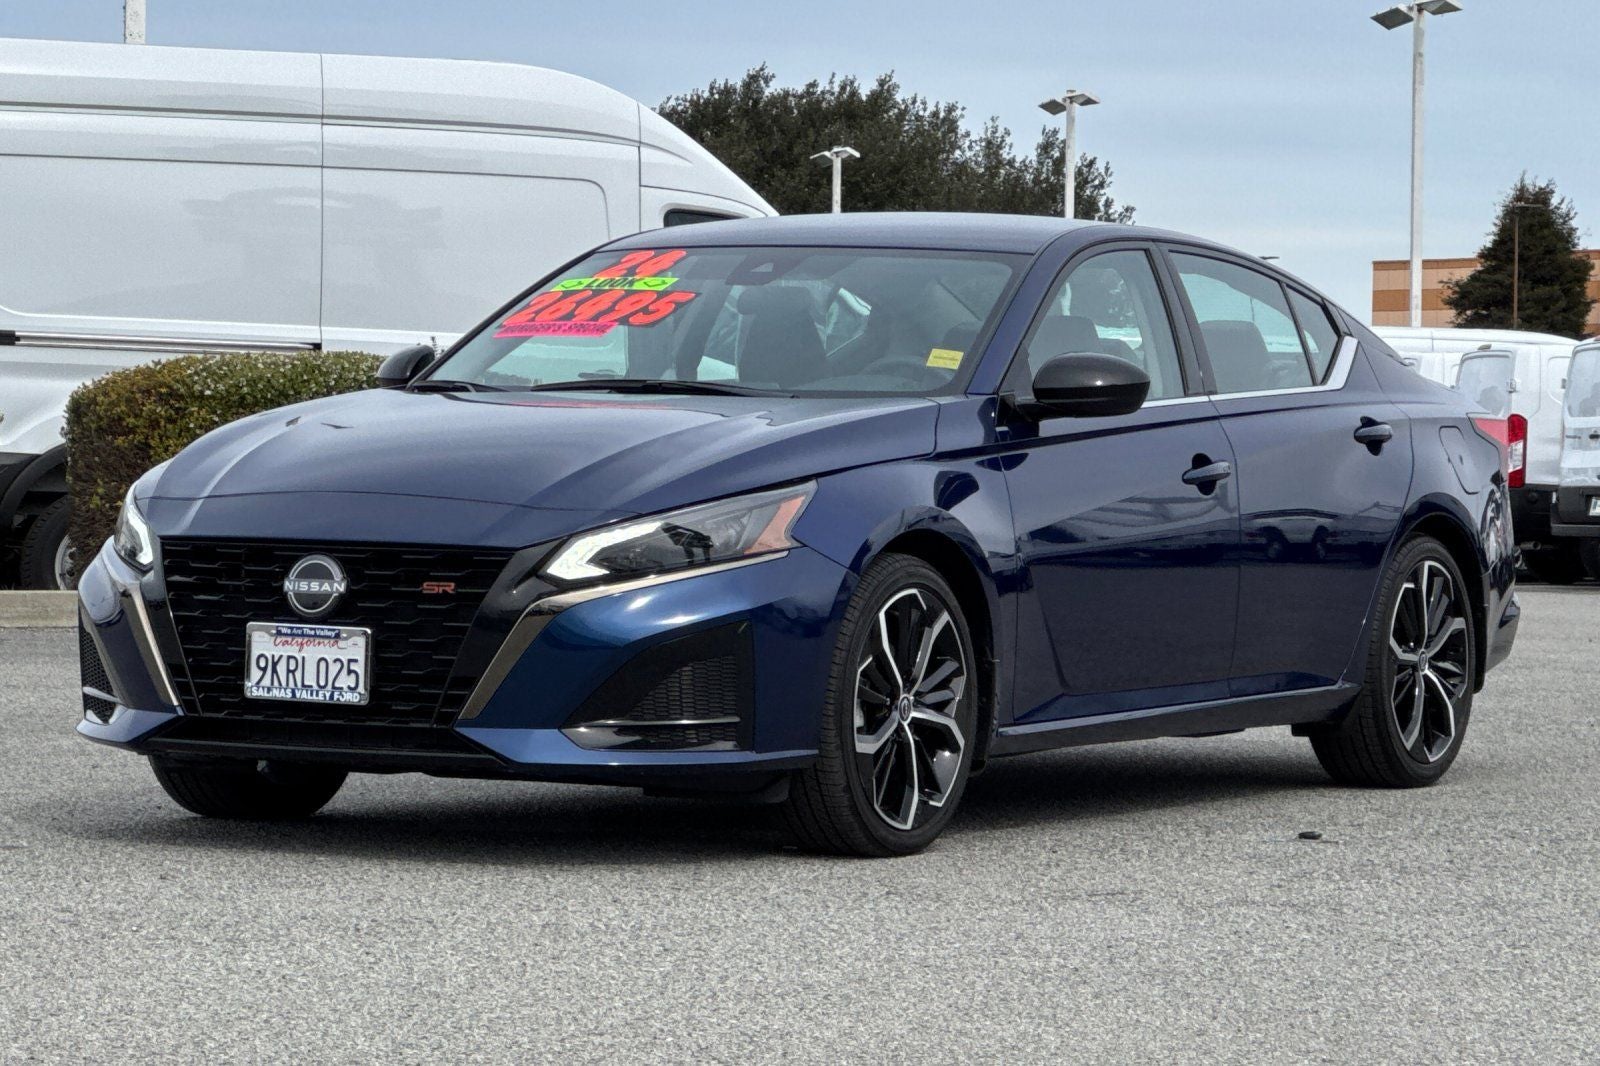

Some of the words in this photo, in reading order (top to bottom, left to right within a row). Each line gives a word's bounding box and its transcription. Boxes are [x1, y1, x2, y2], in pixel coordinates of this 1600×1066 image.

[593, 250, 687, 278] 24
[584, 277, 637, 289] LOOK
[503, 290, 697, 325] 26495
[284, 581, 345, 592] NISSAN
[422, 581, 456, 594] SR
[303, 628, 315, 636] The
[273, 636, 346, 653] California
[255, 653, 360, 691] 9KRL025
[295, 689, 331, 700] VALLEY
[333, 692, 361, 702] FORD
